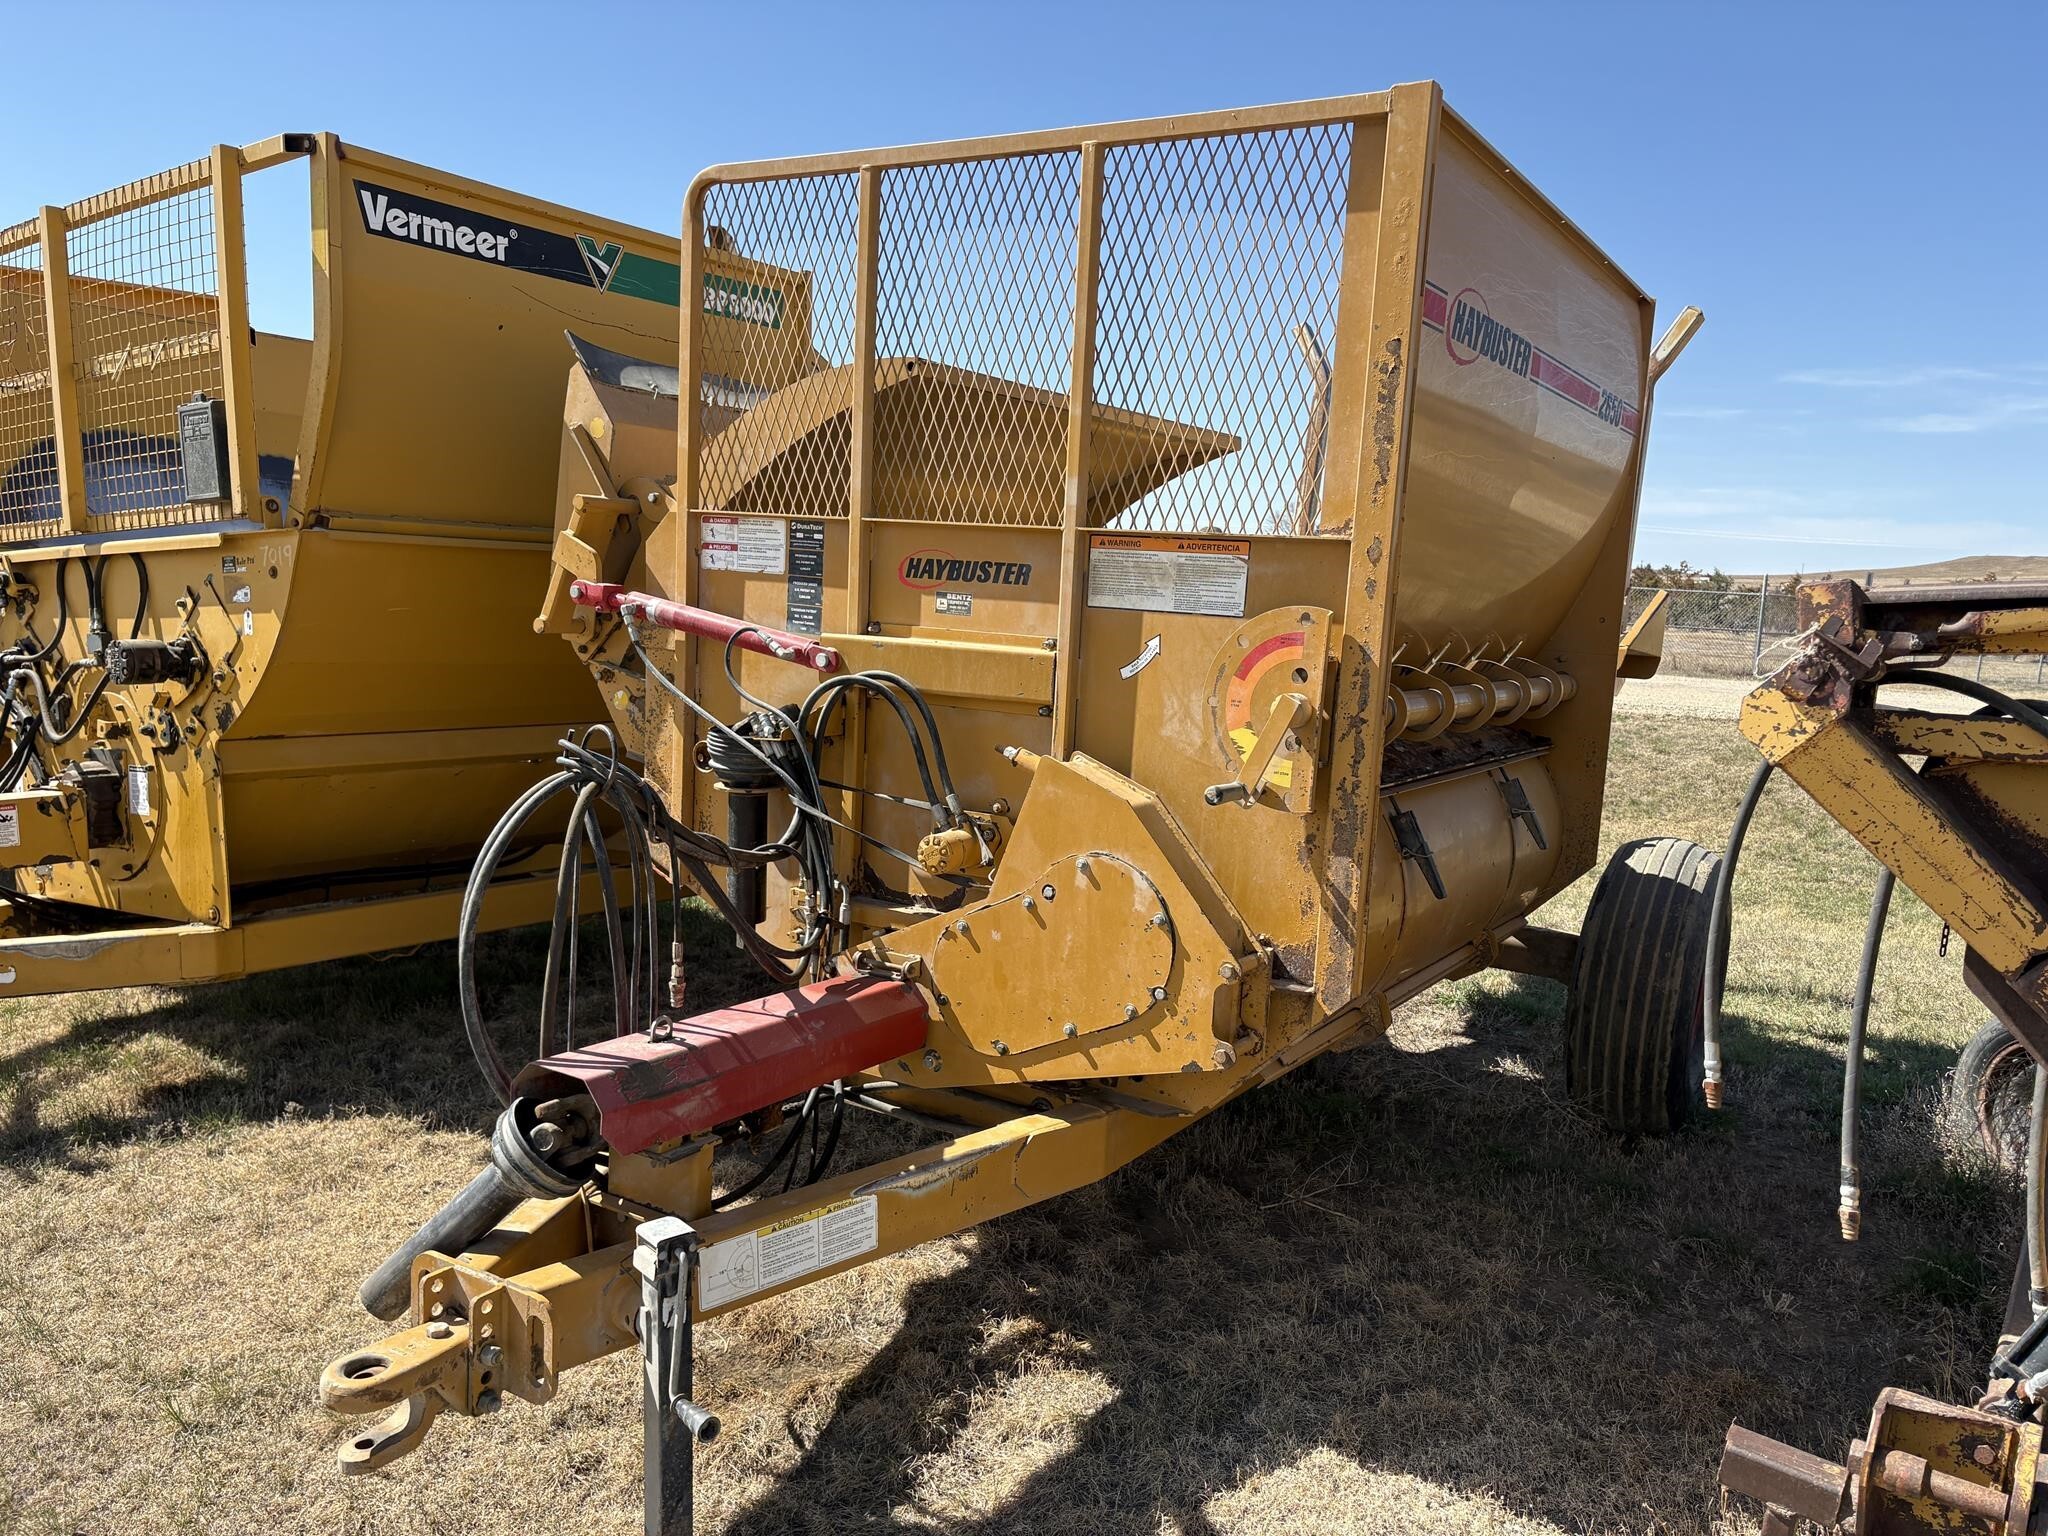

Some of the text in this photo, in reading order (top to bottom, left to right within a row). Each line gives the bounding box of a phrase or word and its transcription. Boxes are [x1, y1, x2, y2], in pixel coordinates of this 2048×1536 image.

[1451, 299, 1532, 379] HAYBUSTER
[1107, 539, 1142, 548] WARNING
[1186, 543, 1241, 552] ADVERTENCIA
[905, 557, 1033, 586] HAYBUSTER
[778, 1217, 804, 1230] CAUTION
